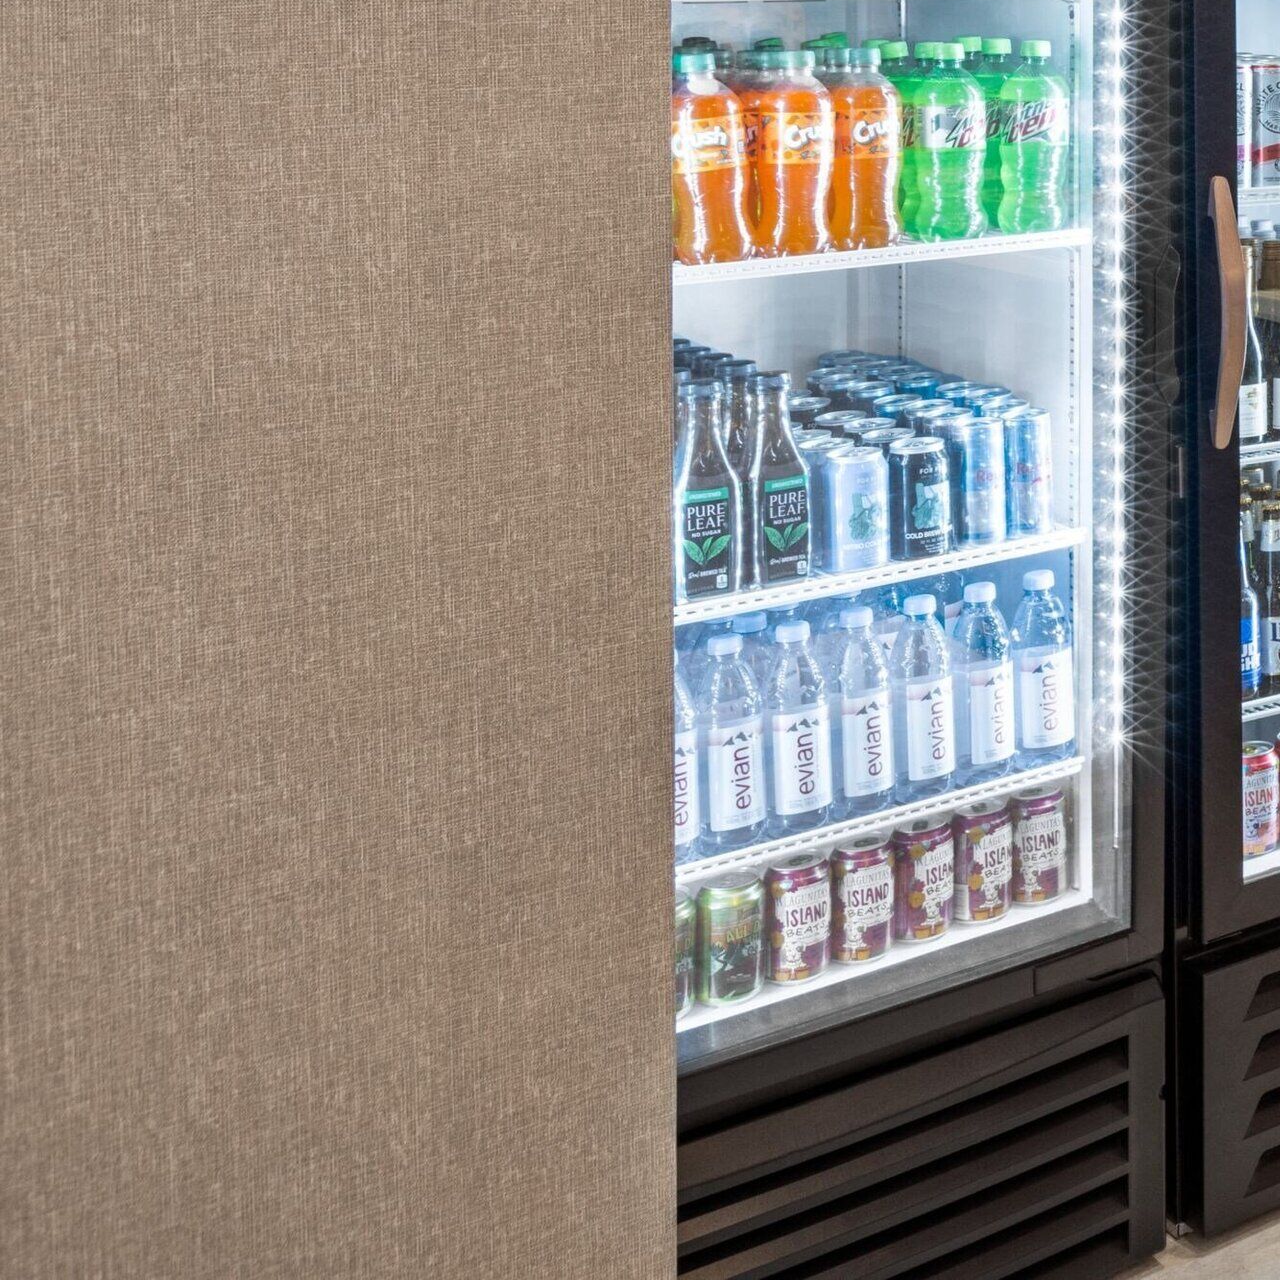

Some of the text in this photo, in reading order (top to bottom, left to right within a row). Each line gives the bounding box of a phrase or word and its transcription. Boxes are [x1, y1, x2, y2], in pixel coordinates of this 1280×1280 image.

[769, 490, 805, 506] PURE
[687, 503, 725, 519] PURE
[769, 502, 804, 519] LEAF
[687, 515, 725, 531] LEAF
[905, 532, 923, 540] COLD
[1040, 676, 1058, 731] evian
[992, 689, 1005, 745] evian
[929, 701, 945, 761] evian
[864, 716, 883, 777] evian
[795, 732, 815, 795] evian
[731, 746, 751, 810] evian
[1022, 831, 1061, 853] ISLAND
[1023, 849, 1060, 863] BEATS
[847, 883, 889, 907] ISLAND
[786, 901, 828, 927] ISLAND
[848, 904, 888, 917] BEATS
[787, 921, 827, 938] BEATS
